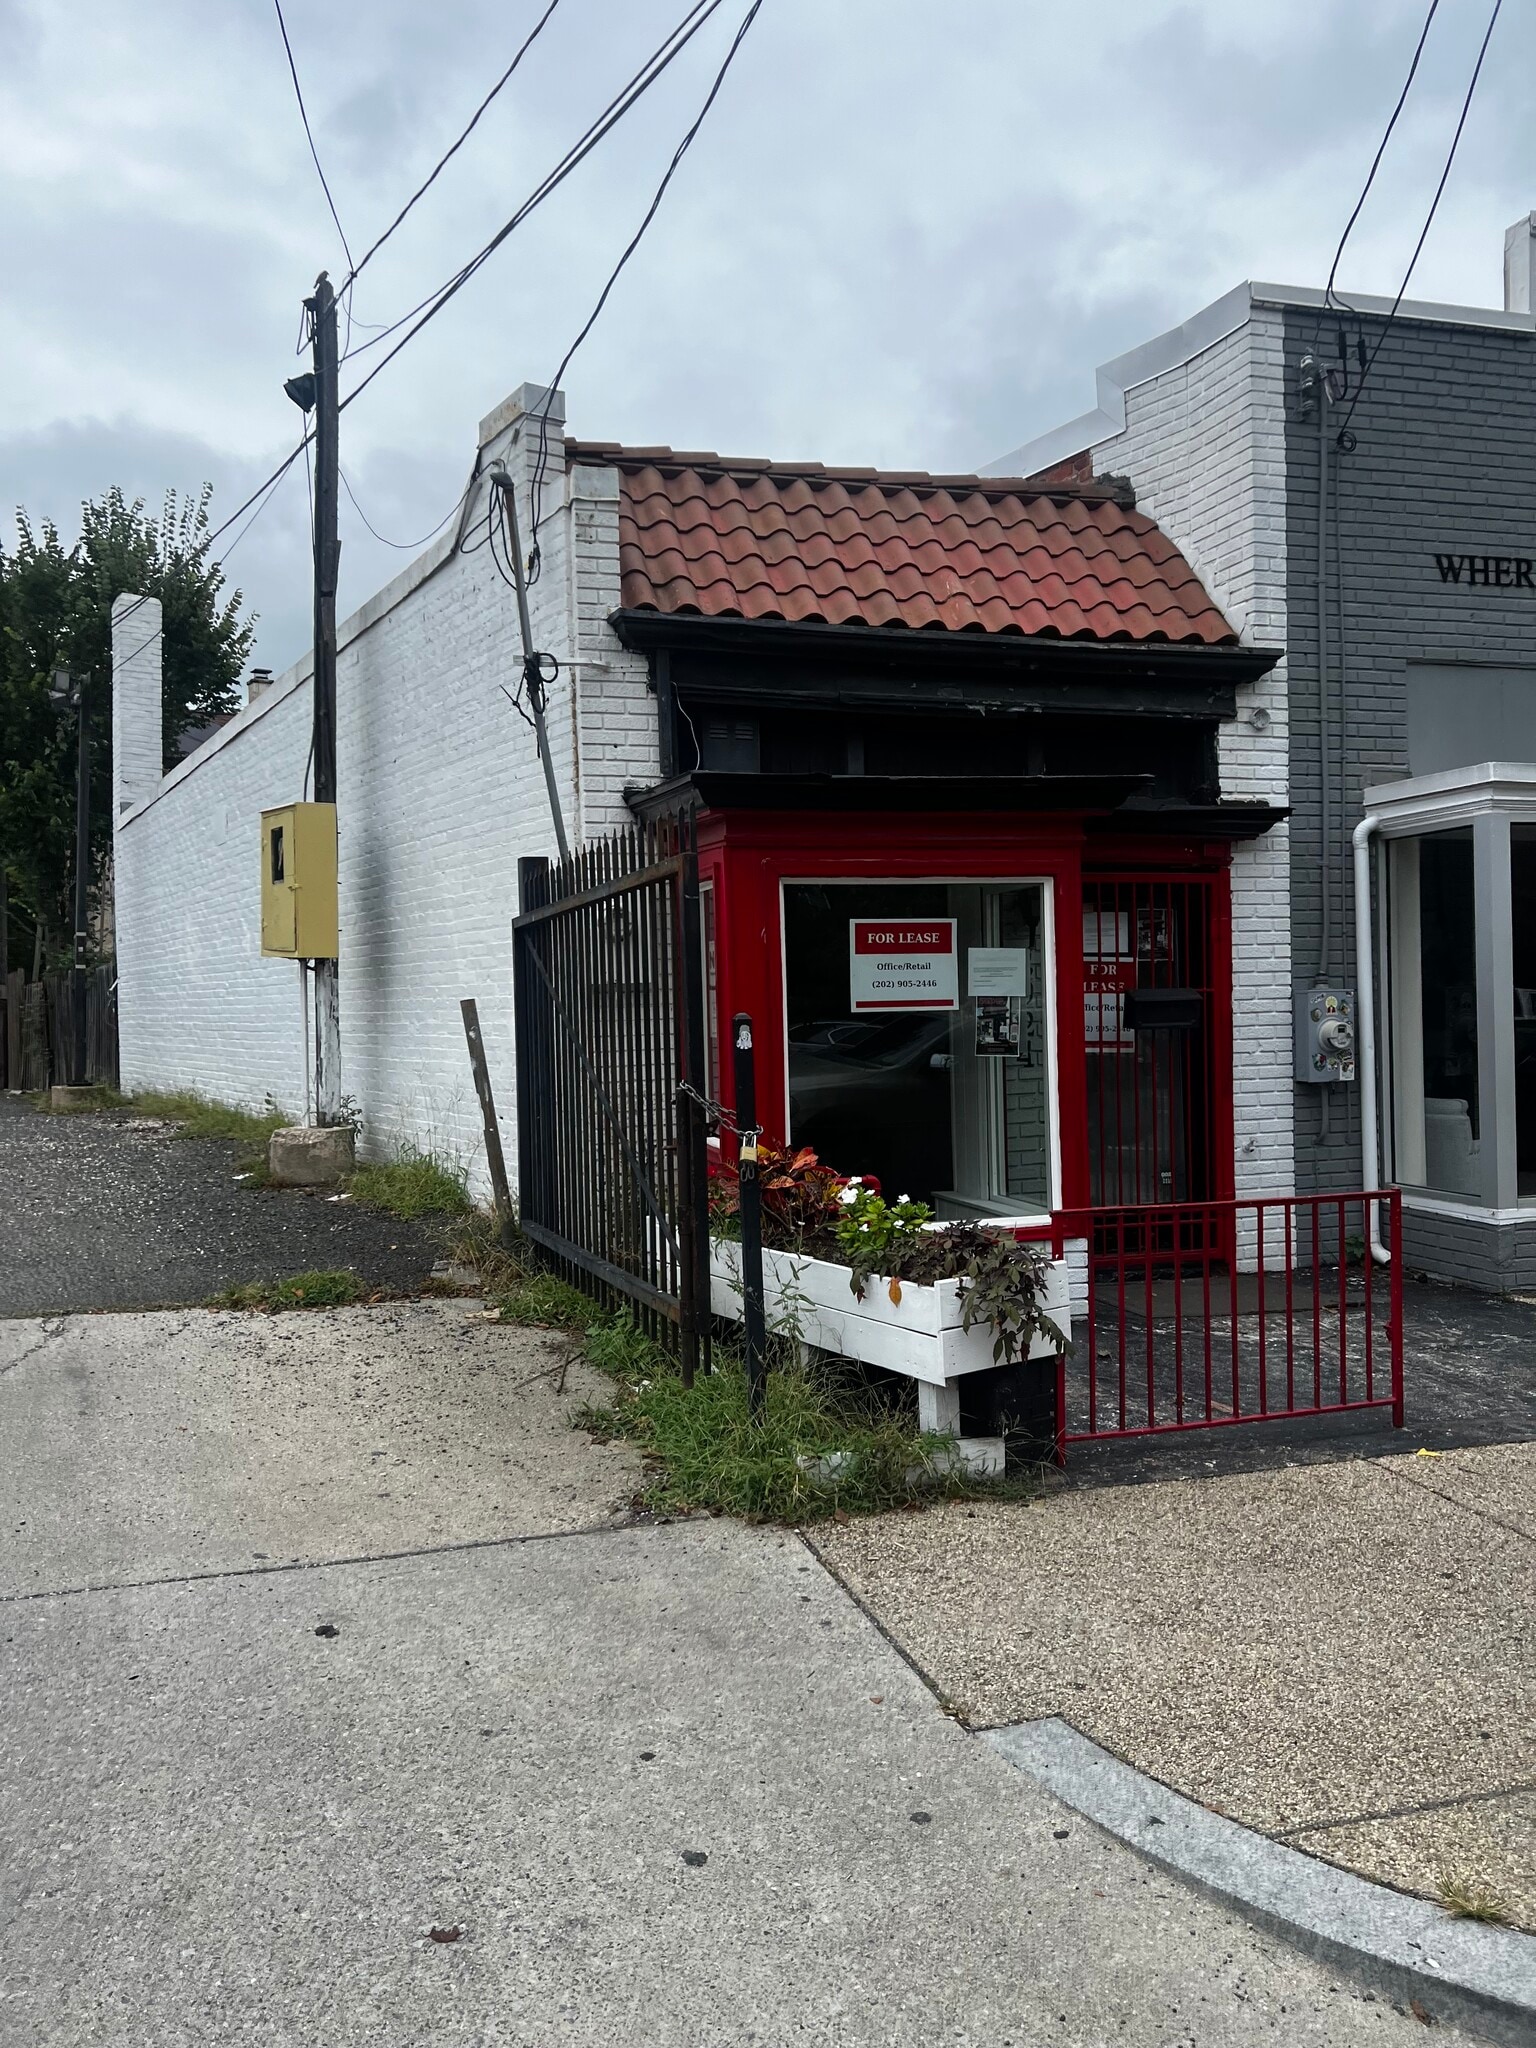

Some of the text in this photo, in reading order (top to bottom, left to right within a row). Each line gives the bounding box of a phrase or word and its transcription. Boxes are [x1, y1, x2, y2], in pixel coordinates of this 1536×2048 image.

[1433, 554, 1536, 588] WHER
[867, 932, 940, 944] FOR LEASE
[876, 962, 931, 971] Office/Retail
[872, 979, 937, 989] (202) 905-2446
